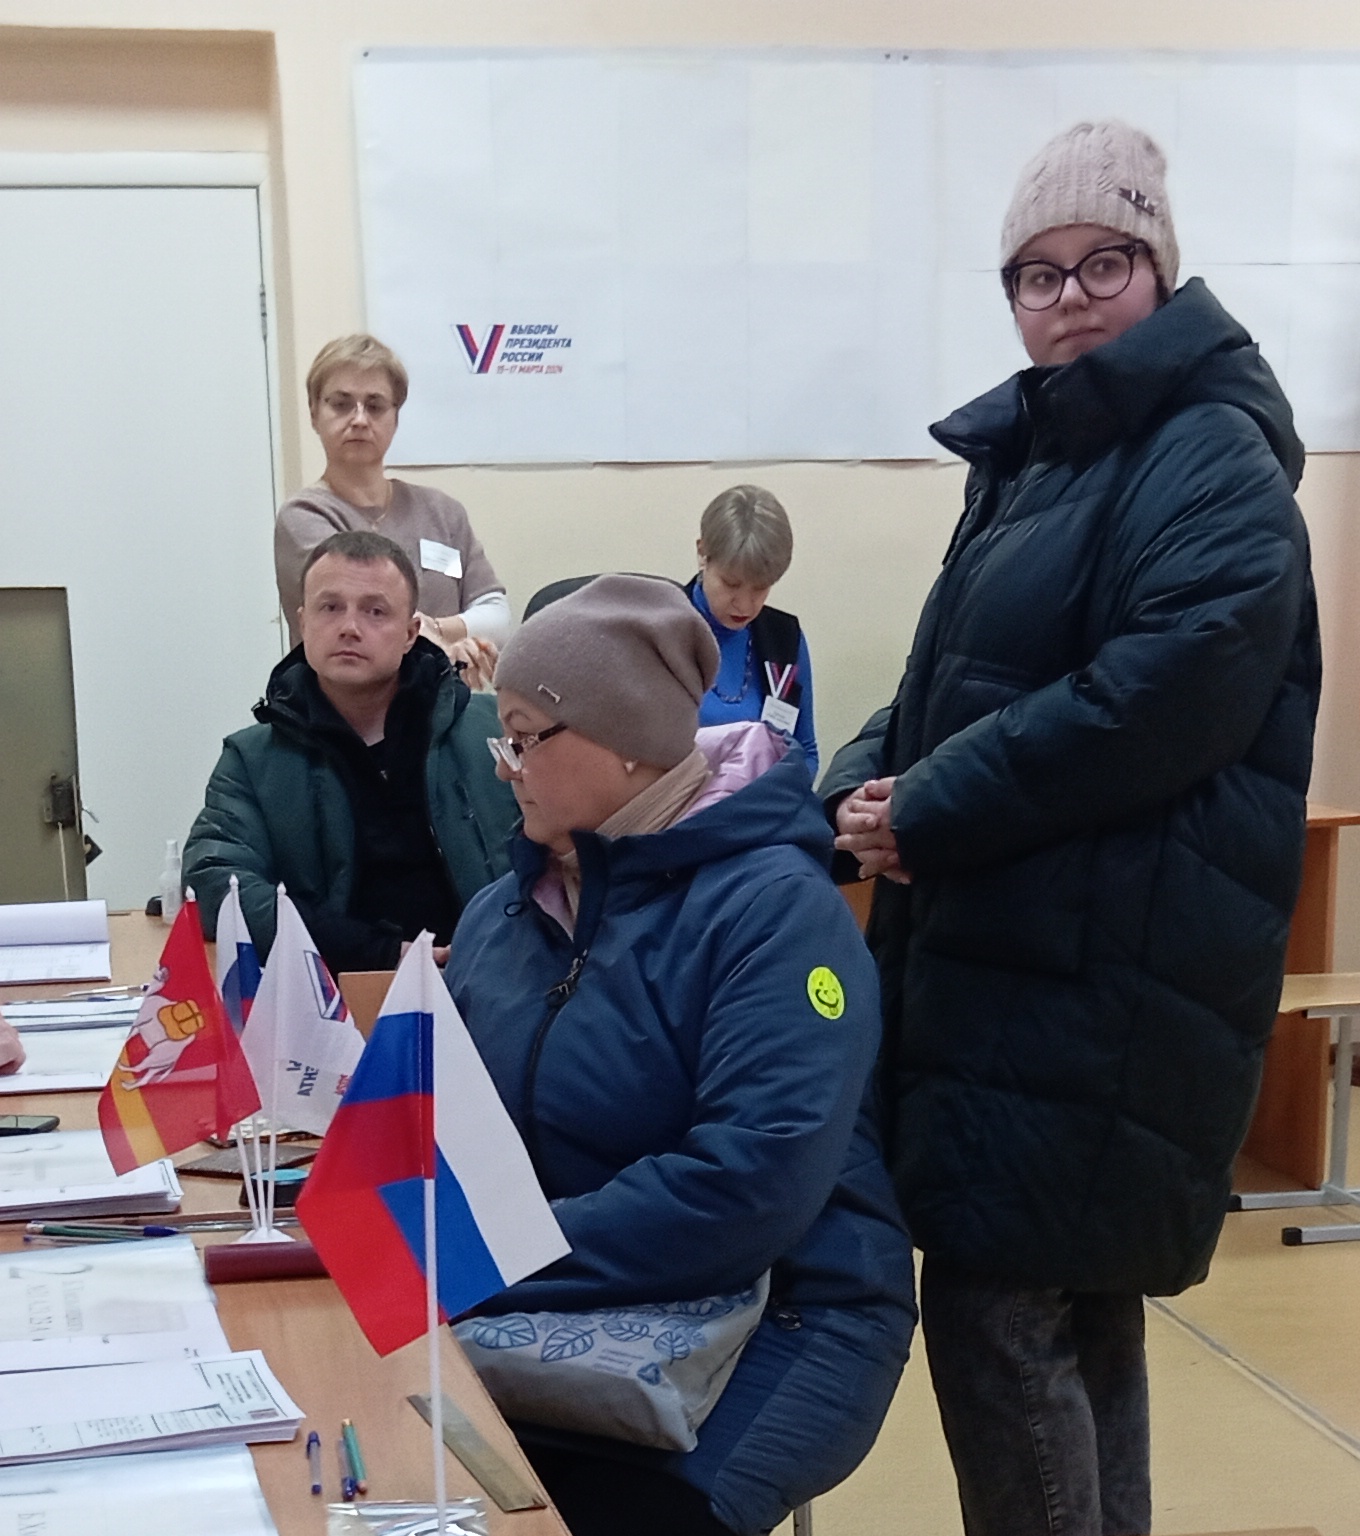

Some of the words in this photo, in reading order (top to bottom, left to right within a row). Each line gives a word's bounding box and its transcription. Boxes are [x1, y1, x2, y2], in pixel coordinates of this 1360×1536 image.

[509, 324, 559, 335] ВЫБОРЫ
[504, 338, 572, 350] ПРЕЗИДЕНТА
[499, 351, 544, 363] РОССИИ
